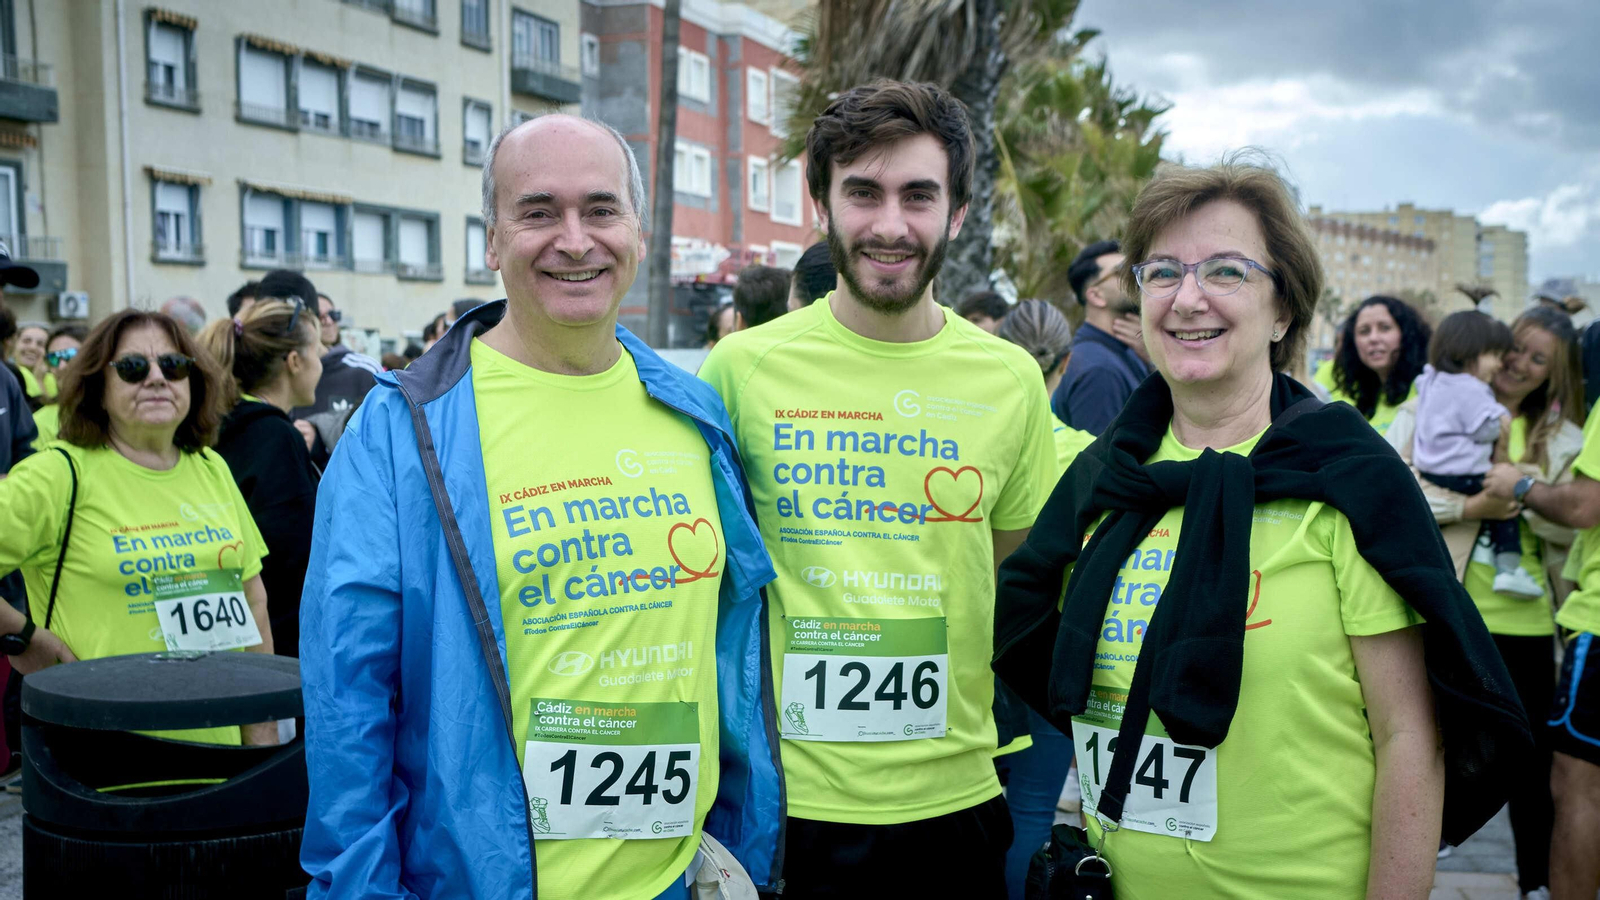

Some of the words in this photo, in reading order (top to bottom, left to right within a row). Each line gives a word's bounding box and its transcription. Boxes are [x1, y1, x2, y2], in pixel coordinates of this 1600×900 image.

[775, 410, 785, 419] IX
[787, 408, 818, 419] CÁDIZ
[821, 410, 835, 420] EN
[838, 411, 883, 421] MARCHA
[774, 423, 815, 451] En
[826, 429, 959, 461] marcha
[774, 458, 886, 488] contra
[500, 494, 512, 504] IX
[514, 485, 549, 501] CÁDIZ
[550, 481, 567, 492] EN
[568, 476, 613, 489] MARCHA
[502, 503, 556, 538] En
[563, 487, 692, 523] marcha
[777, 490, 803, 519] el
[812, 491, 933, 525] cáncer
[113, 535, 147, 554] En
[150, 525, 233, 550] marcha
[780, 527, 813, 536] ASOCIACIÓN
[814, 529, 852, 537] ESPAÑOLA
[852, 531, 882, 539] CONTRA
[892, 533, 920, 541] CÁNCER
[119, 551, 196, 575] contra
[512, 529, 633, 574] contra
[124, 577, 152, 597] el
[518, 574, 557, 608] el
[564, 564, 681, 600] cáncer
[843, 570, 942, 591] HYUNDAI
[522, 613, 567, 626] ASOCIACIÓN
[569, 609, 608, 620] ESPAÑOLA
[609, 604, 639, 614] CONTRA
[648, 600, 673, 609] CÁNCER
[842, 593, 905, 606] Guadalete
[907, 596, 941, 607] Moto
[170, 596, 246, 635] 1640
[792, 619, 821, 630] Cádiz
[823, 622, 837, 630] en
[839, 622, 881, 631] marcha
[794, 630, 828, 639] contra
[830, 631, 841, 640] el
[843, 631, 882, 642] cáncer
[600, 641, 693, 670] HYUNDAI
[598, 670, 664, 687] Guadalete
[667, 667, 694, 680] Mtor
[804, 659, 940, 711] 1246
[537, 702, 572, 714] Cádiz
[575, 706, 591, 715] en
[594, 706, 637, 717] marcha
[1086, 698, 1102, 709] ntra
[1103, 701, 1110, 711] el
[539, 715, 580, 726] contra
[583, 716, 595, 727] el
[598, 717, 637, 729] cáncer
[550, 749, 692, 806] 1245
